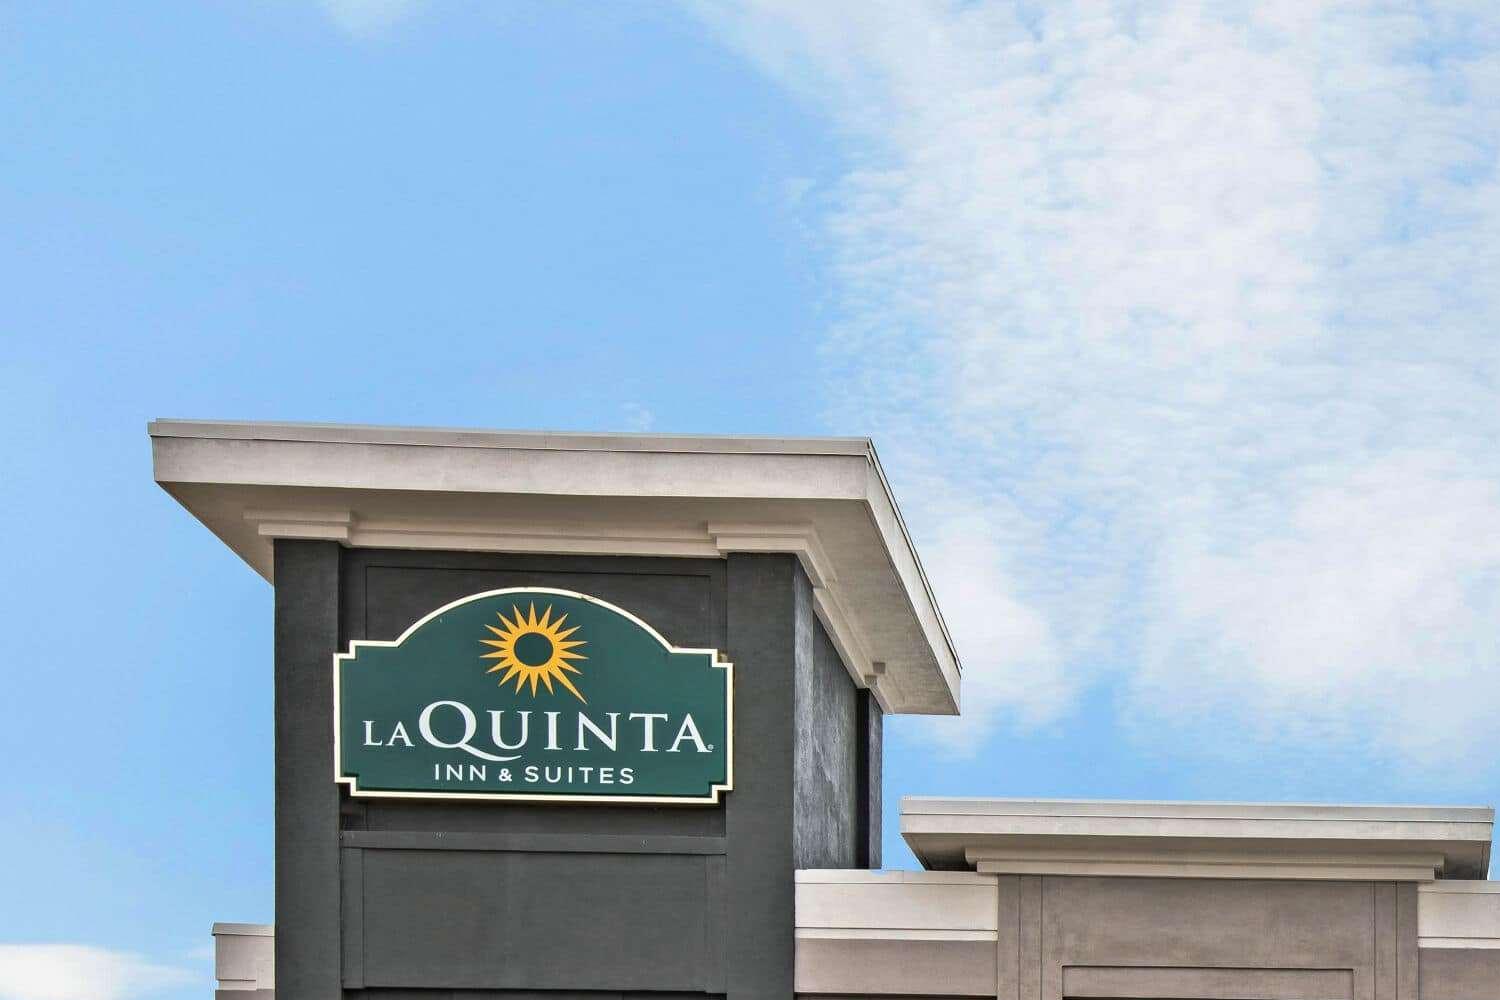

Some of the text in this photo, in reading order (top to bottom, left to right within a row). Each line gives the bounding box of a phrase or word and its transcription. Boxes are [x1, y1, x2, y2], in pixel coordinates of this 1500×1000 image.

[362, 700, 713, 762] LA QUINTA
[434, 763, 635, 785] INN & SUITES
